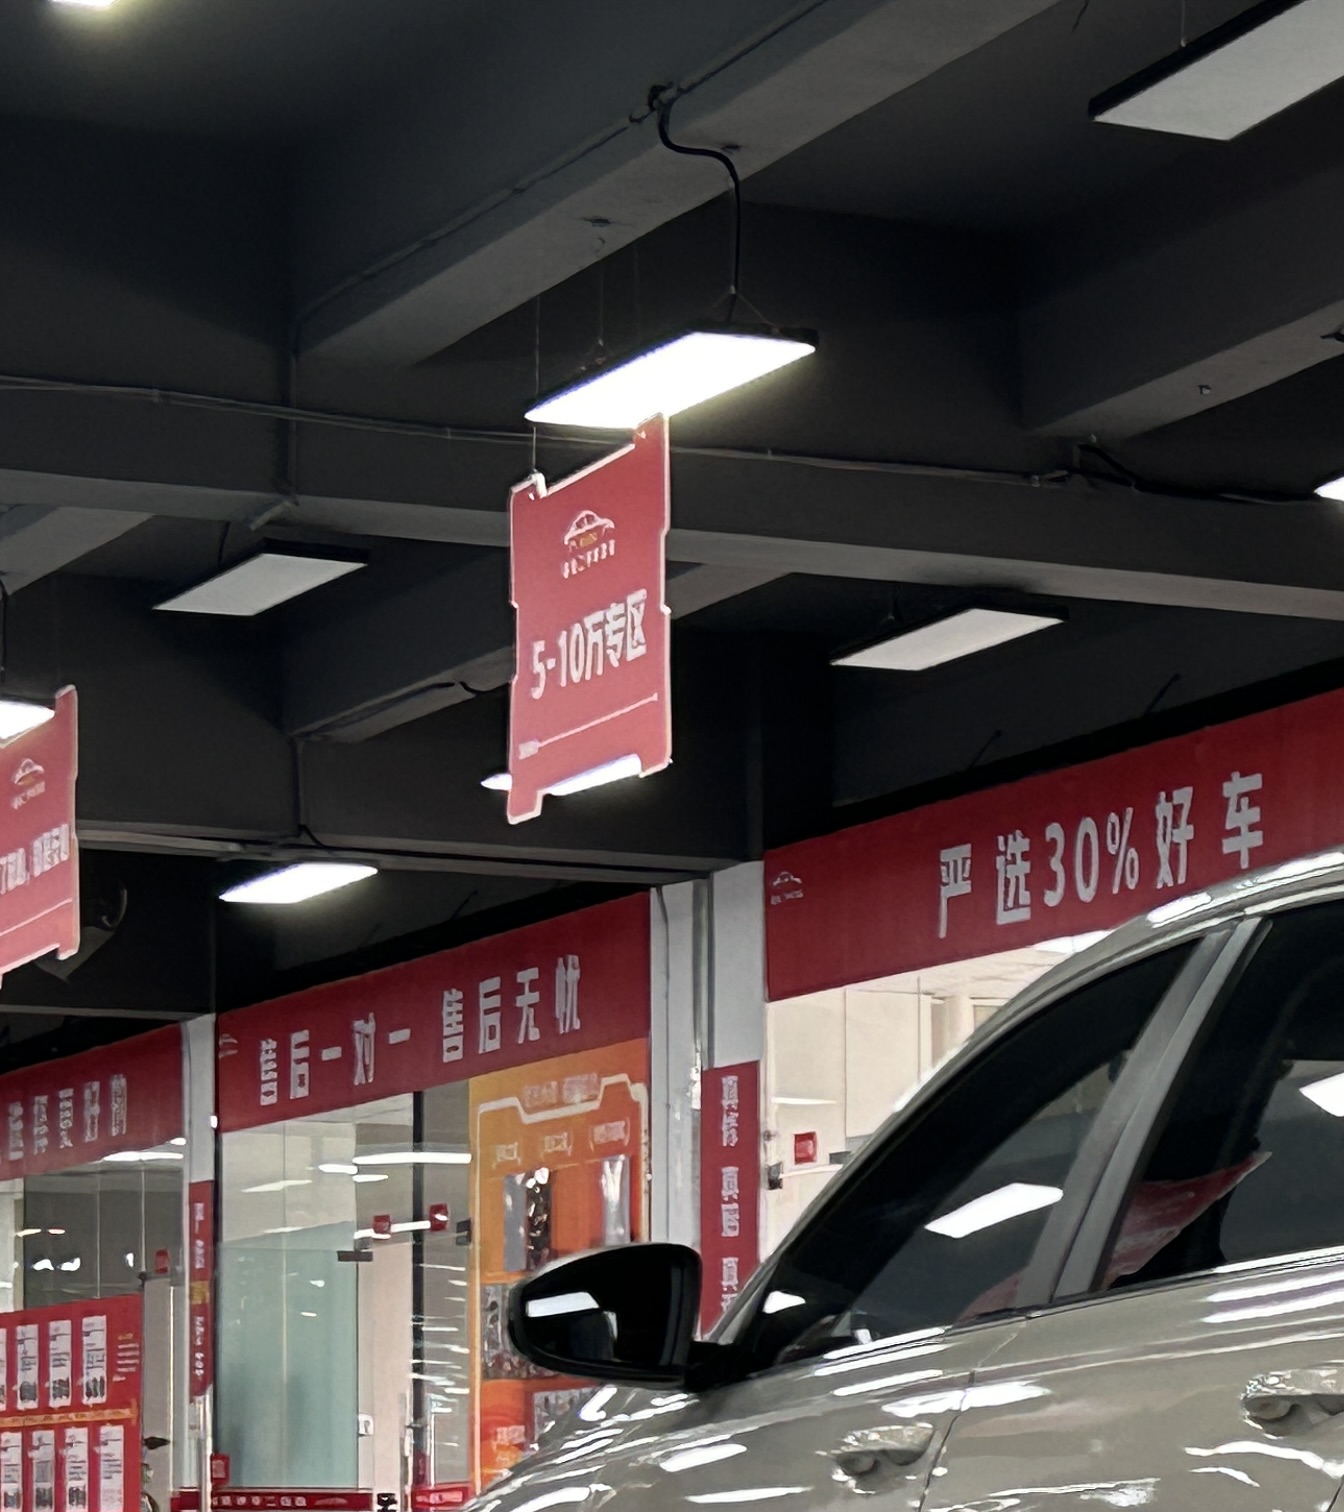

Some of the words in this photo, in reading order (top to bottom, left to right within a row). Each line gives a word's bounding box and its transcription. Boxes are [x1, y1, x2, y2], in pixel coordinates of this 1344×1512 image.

[531, 588, 647, 700] 5-10万专区
[937, 771, 1264, 939] 严选30%好车
[260, 1012, 411, 1106] 售后一对一
[442, 954, 581, 1063] 售后无忧
